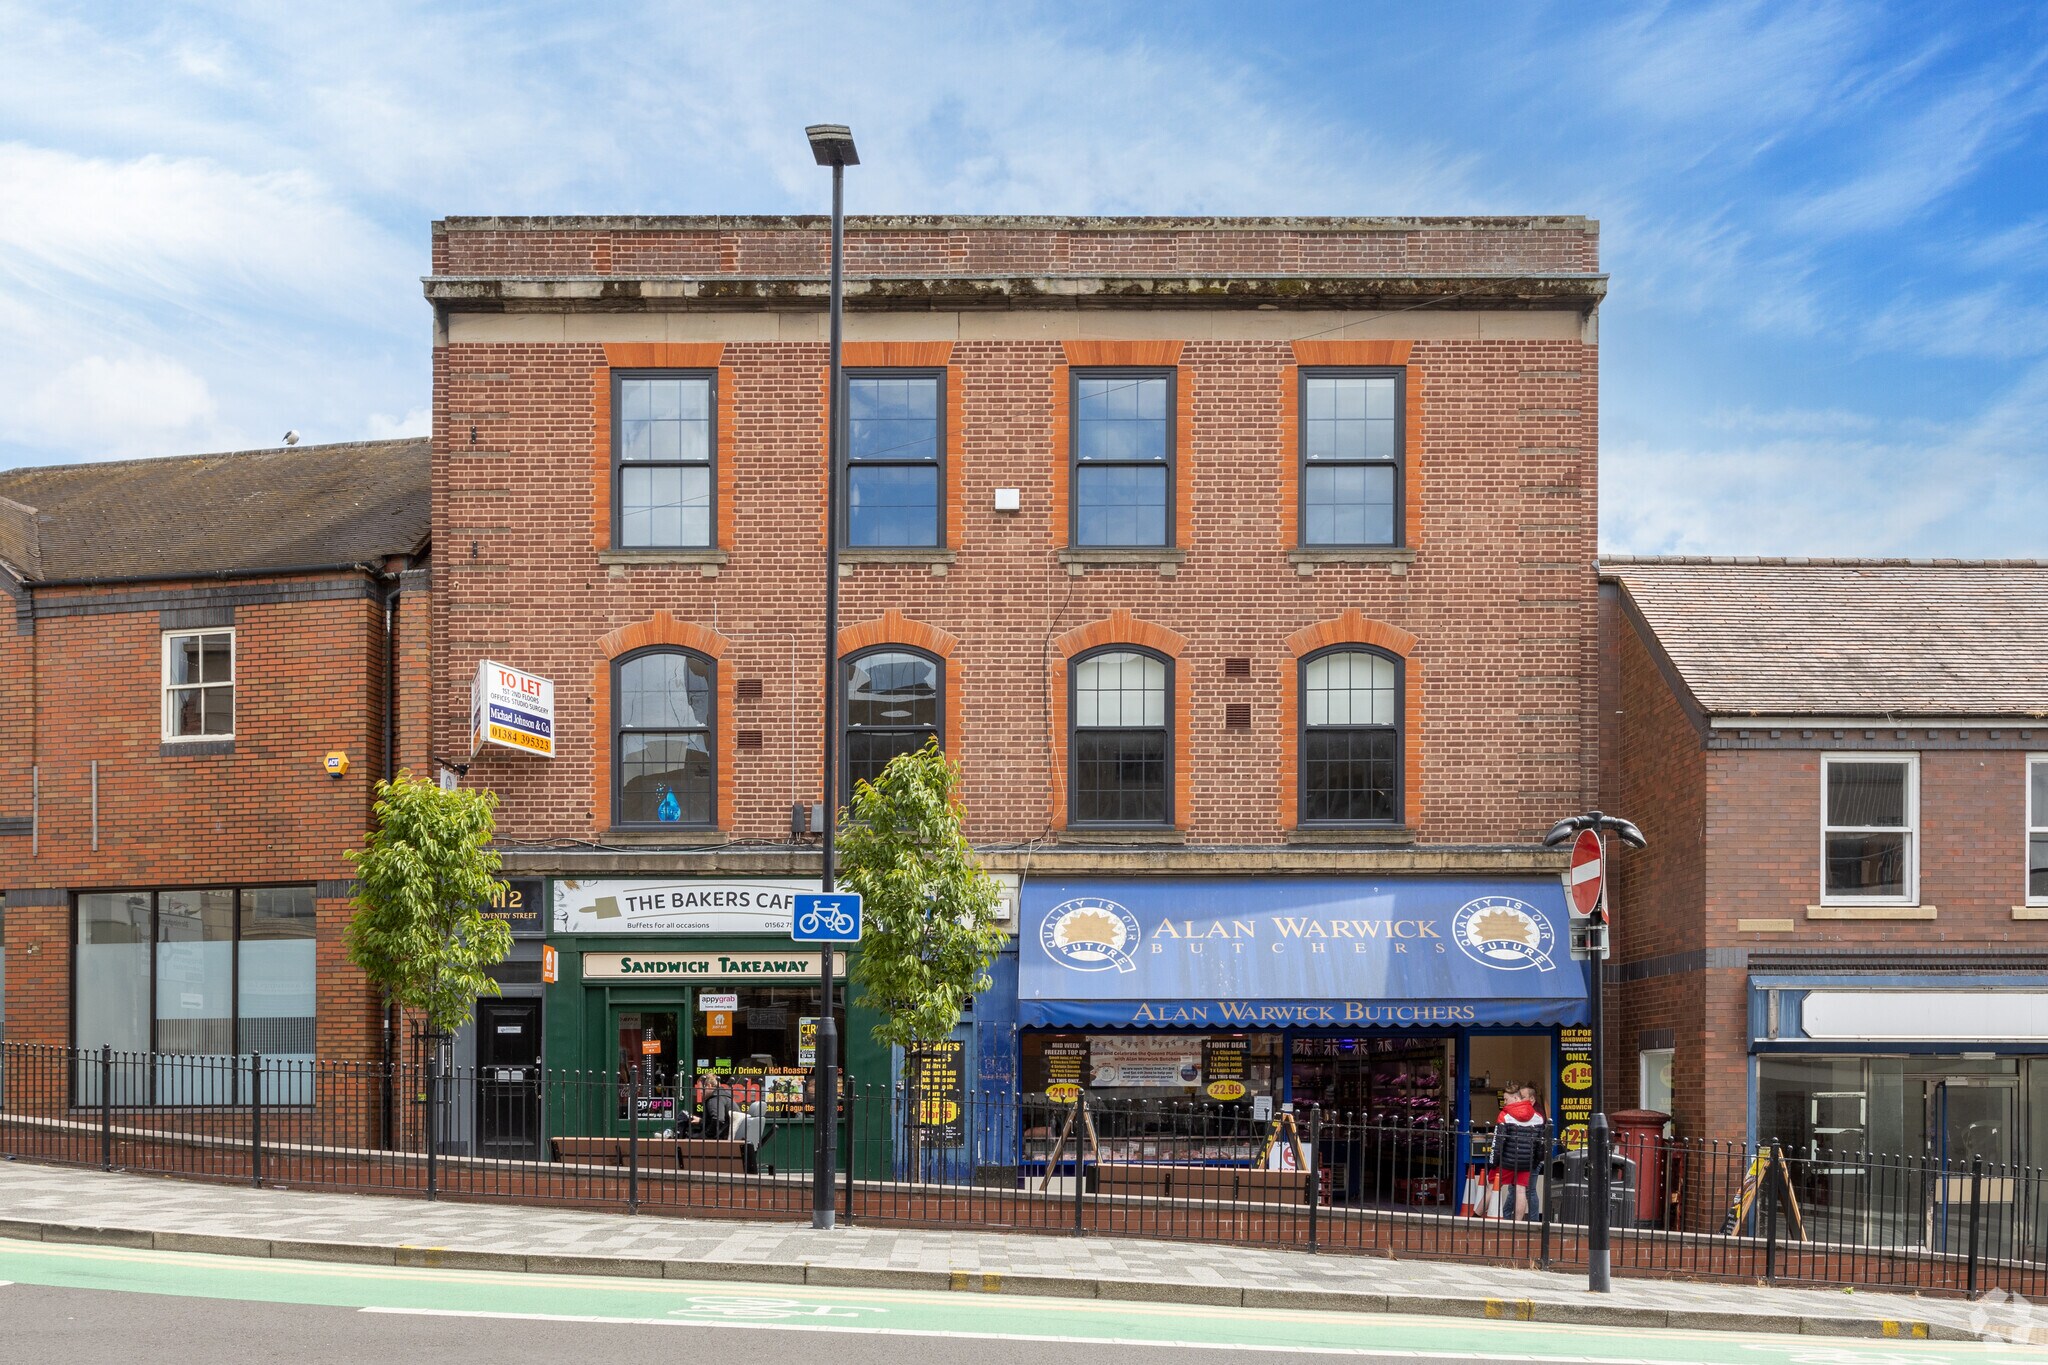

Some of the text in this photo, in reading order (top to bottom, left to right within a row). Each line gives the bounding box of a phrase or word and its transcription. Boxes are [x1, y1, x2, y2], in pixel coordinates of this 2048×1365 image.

[499, 671, 542, 696] TO LET
[490, 693, 549, 714] OFFICES STUDIO SURGERY
[522, 693, 540, 704] FLOORS
[490, 708, 512, 722] Michael
[514, 712, 534, 728] Johnson
[536, 720, 541, 731] &
[492, 727, 550, 751] 01384 395323
[328, 758, 338, 766] ADT
[626, 892, 794, 912] THE BAKERS CAF
[1044, 900, 1137, 948] QUALITY IS OUR
[1152, 918, 1442, 939] ALAN WARWICK
[1456, 899, 1551, 947] QUALITY IS OUR
[1060, 942, 1128, 966] FUTURE
[1151, 942, 1446, 954] BUTCHERS
[1477, 941, 1546, 964] FUTURE
[620, 957, 809, 974] SANDWICH TAKEAWAY
[750, 1014, 786, 1026] OPEN
[1132, 1002, 1475, 1021] ALAN WARWICK BUTCHERS
[801, 1024, 818, 1034] CIR
[696, 1066, 808, 1074] Breakfast Drinks Hot Roasts
[694, 1078, 761, 1102] fsh
[1210, 1085, 1242, 1094] £22.99
